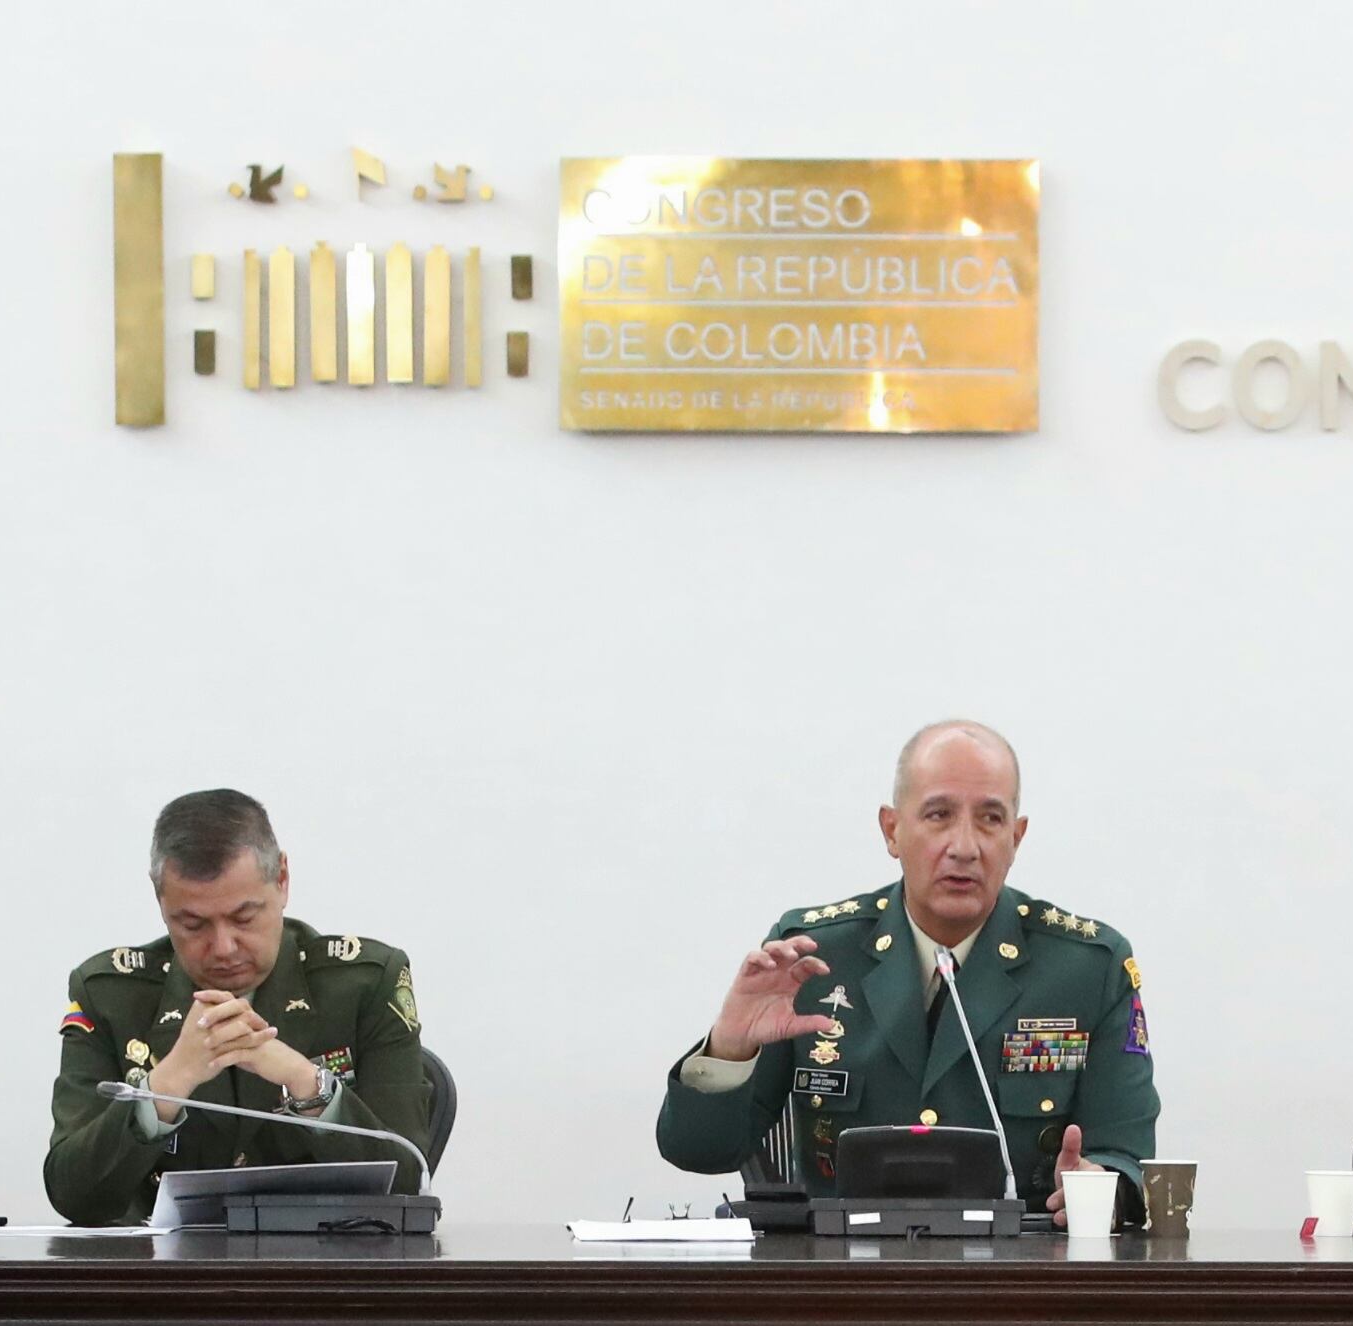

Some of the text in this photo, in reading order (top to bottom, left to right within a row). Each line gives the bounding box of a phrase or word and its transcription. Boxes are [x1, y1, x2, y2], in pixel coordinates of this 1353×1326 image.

[582, 246, 1019, 296] DE LA REPÚBLICA
[581, 321, 928, 362] DE COLOMBIA
